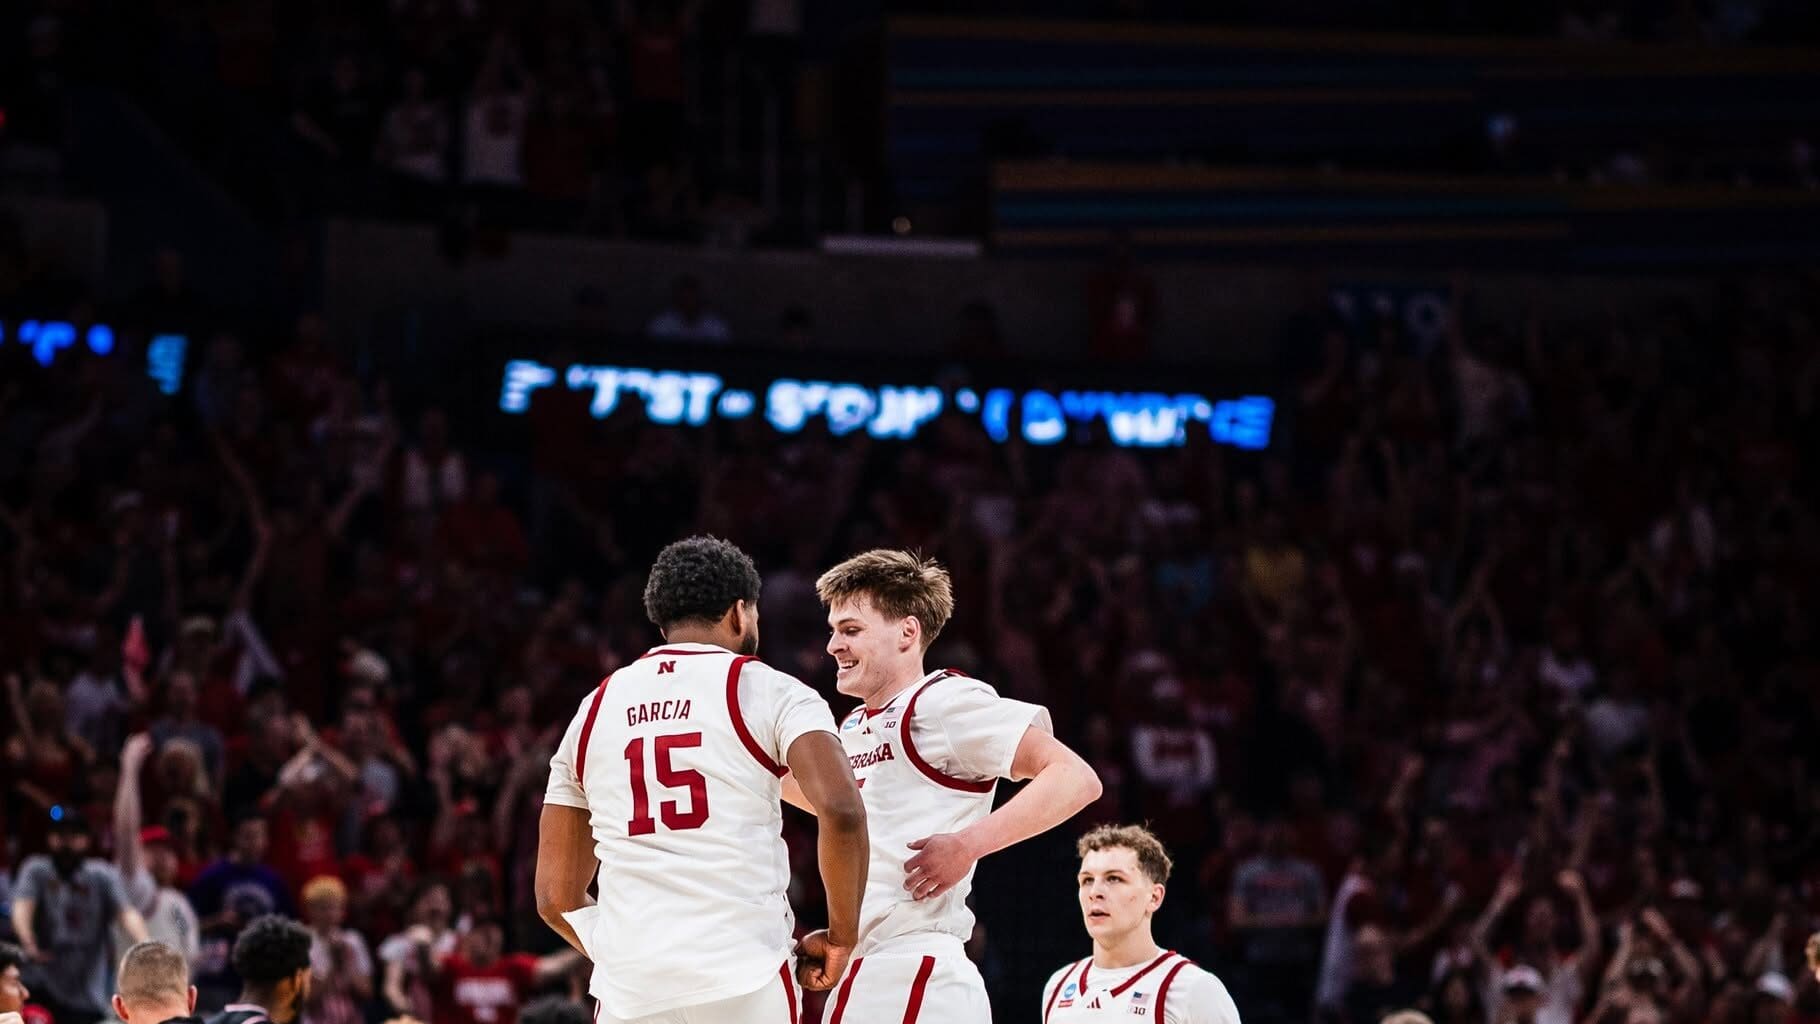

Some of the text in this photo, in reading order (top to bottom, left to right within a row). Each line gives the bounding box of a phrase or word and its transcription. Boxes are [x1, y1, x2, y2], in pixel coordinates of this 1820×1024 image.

[657, 660, 677, 675] N
[627, 699, 692, 727] GARCIA
[624, 731, 710, 837] 15
